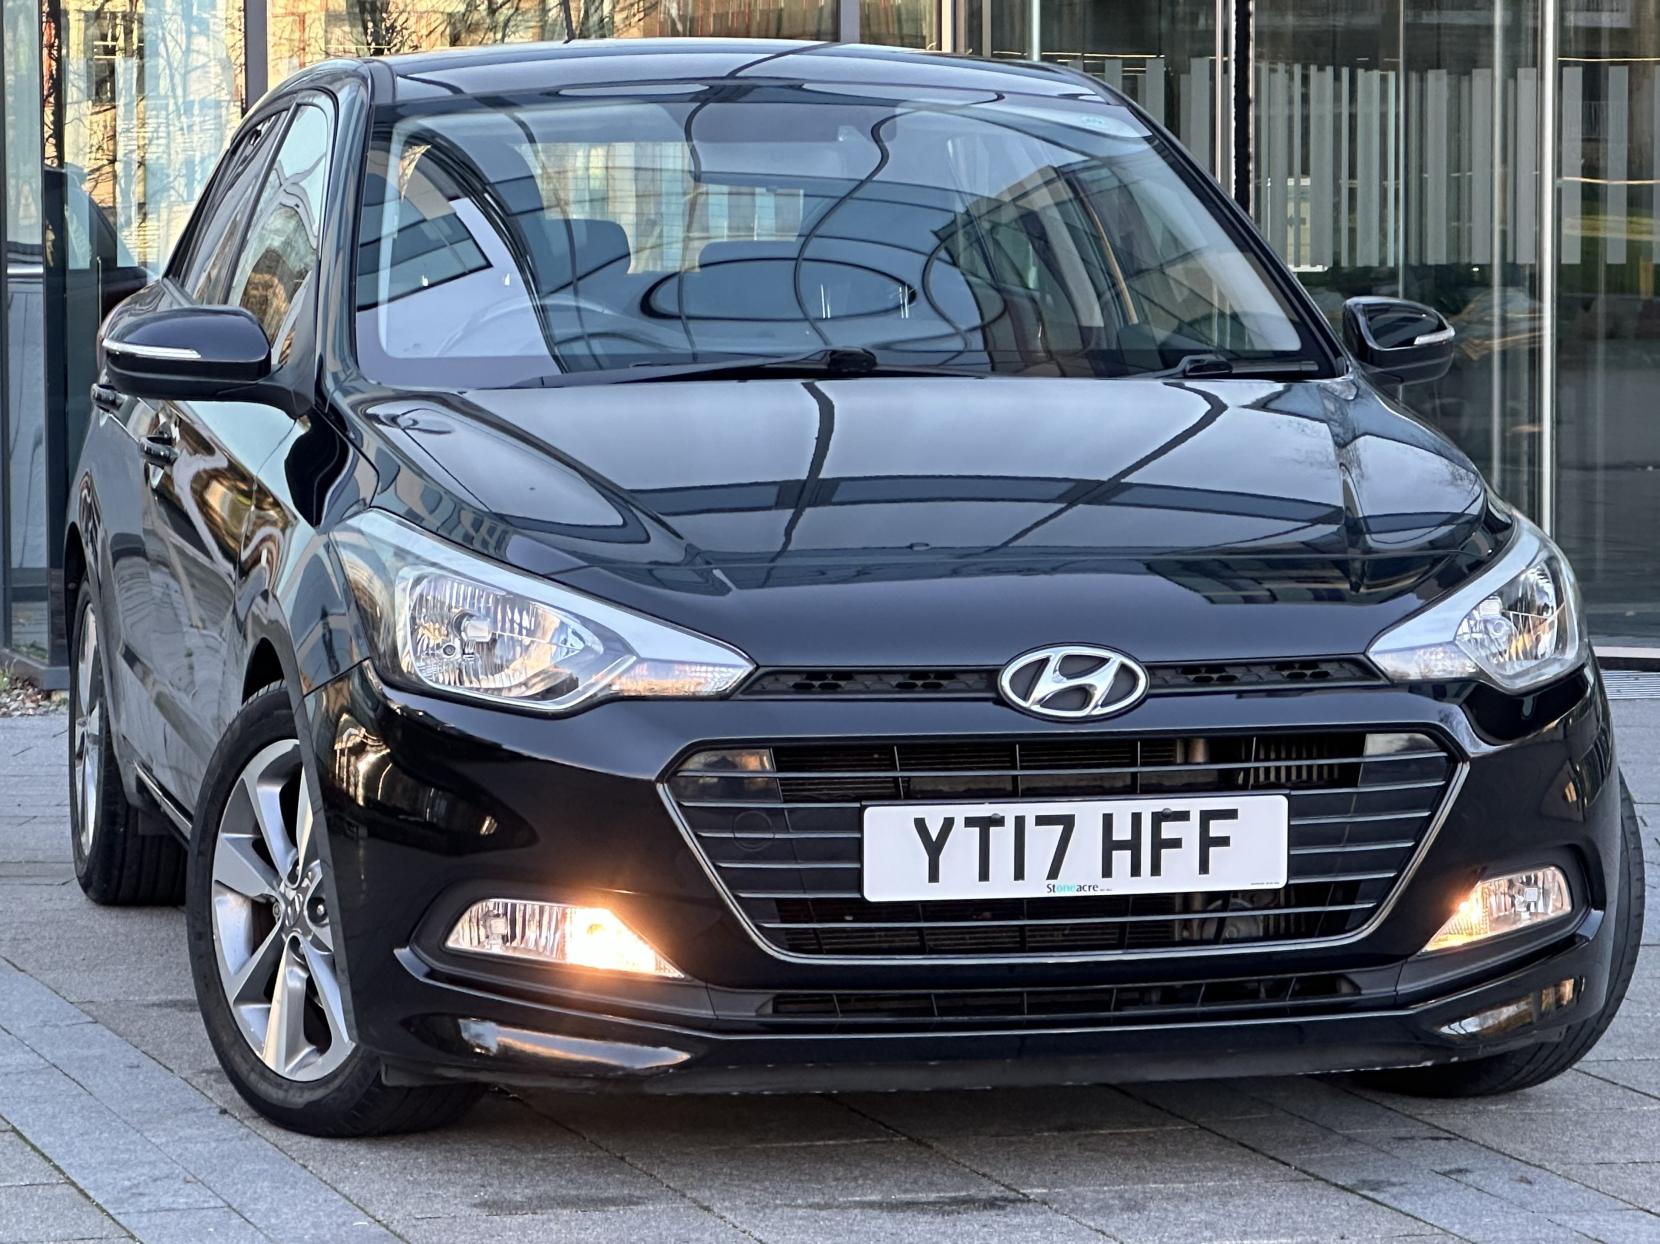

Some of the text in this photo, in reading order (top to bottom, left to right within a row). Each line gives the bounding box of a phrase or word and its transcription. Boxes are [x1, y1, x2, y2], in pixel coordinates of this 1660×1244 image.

[914, 808, 1239, 883] YT17 HFF
[1046, 883, 1099, 893] Stoneacre
